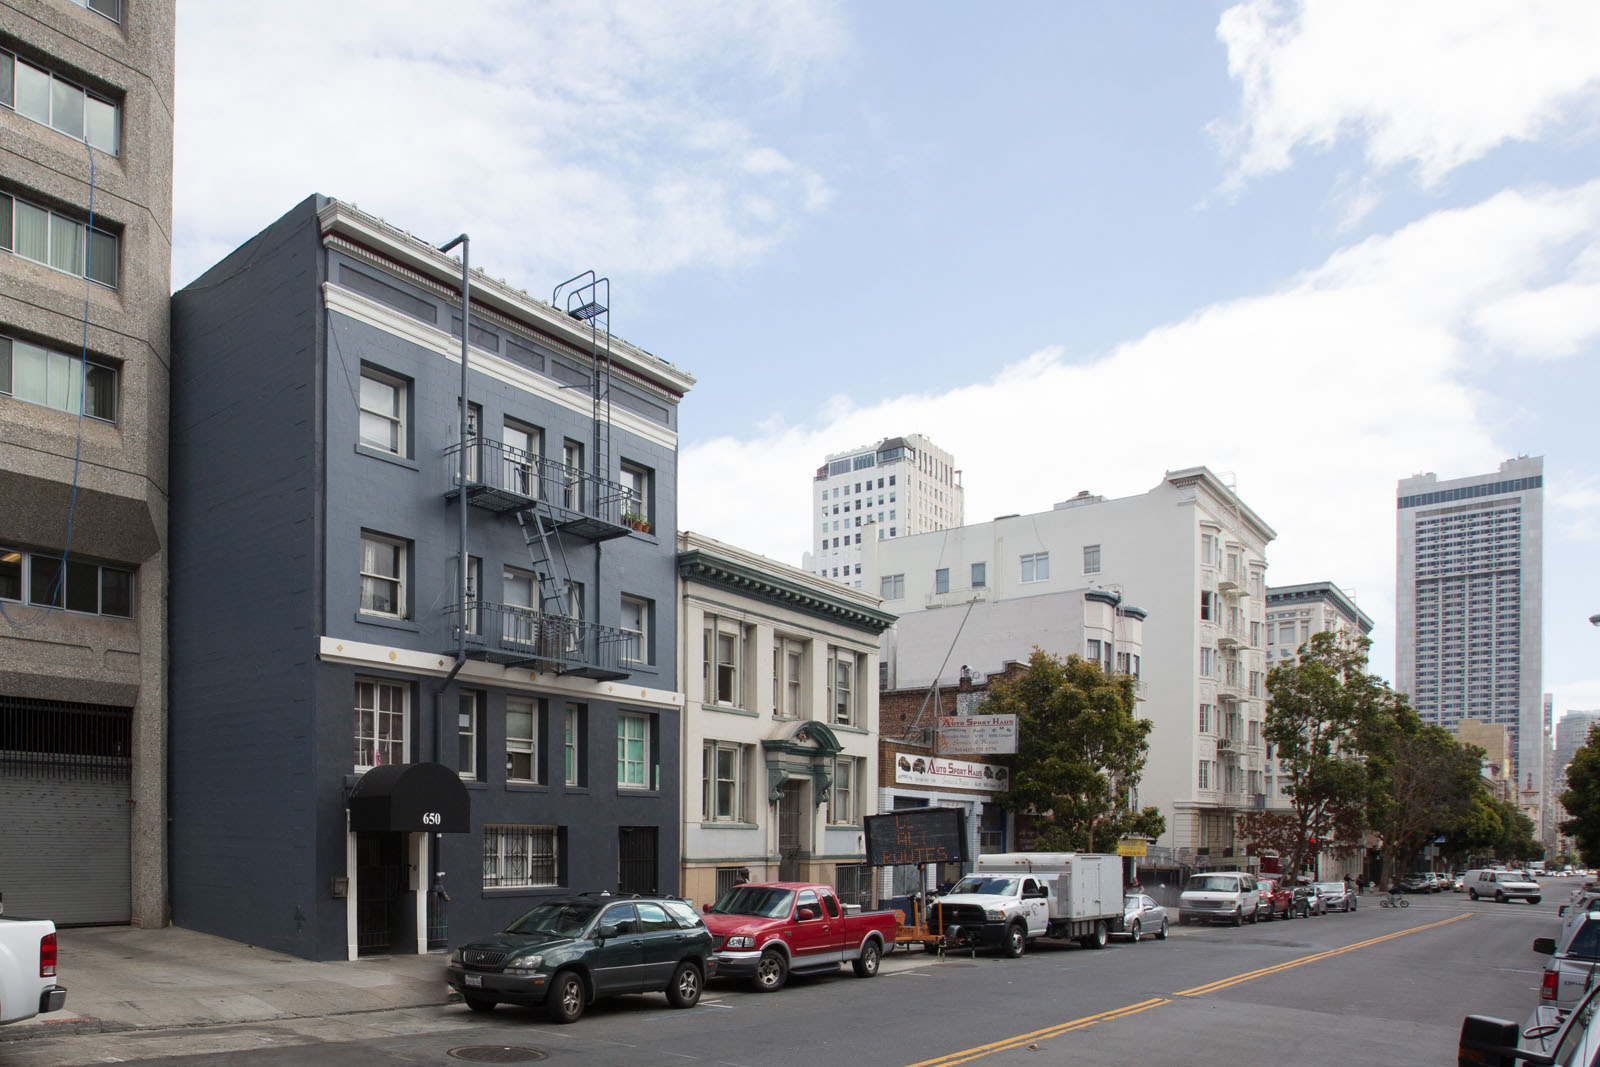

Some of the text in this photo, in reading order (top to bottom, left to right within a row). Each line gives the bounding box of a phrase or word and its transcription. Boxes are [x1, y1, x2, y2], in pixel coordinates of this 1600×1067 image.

[941, 717, 1014, 728] AUTO SPORT HAUS
[927, 758, 983, 777] AUTO SPORT HAUS
[423, 812, 441, 825] 650
